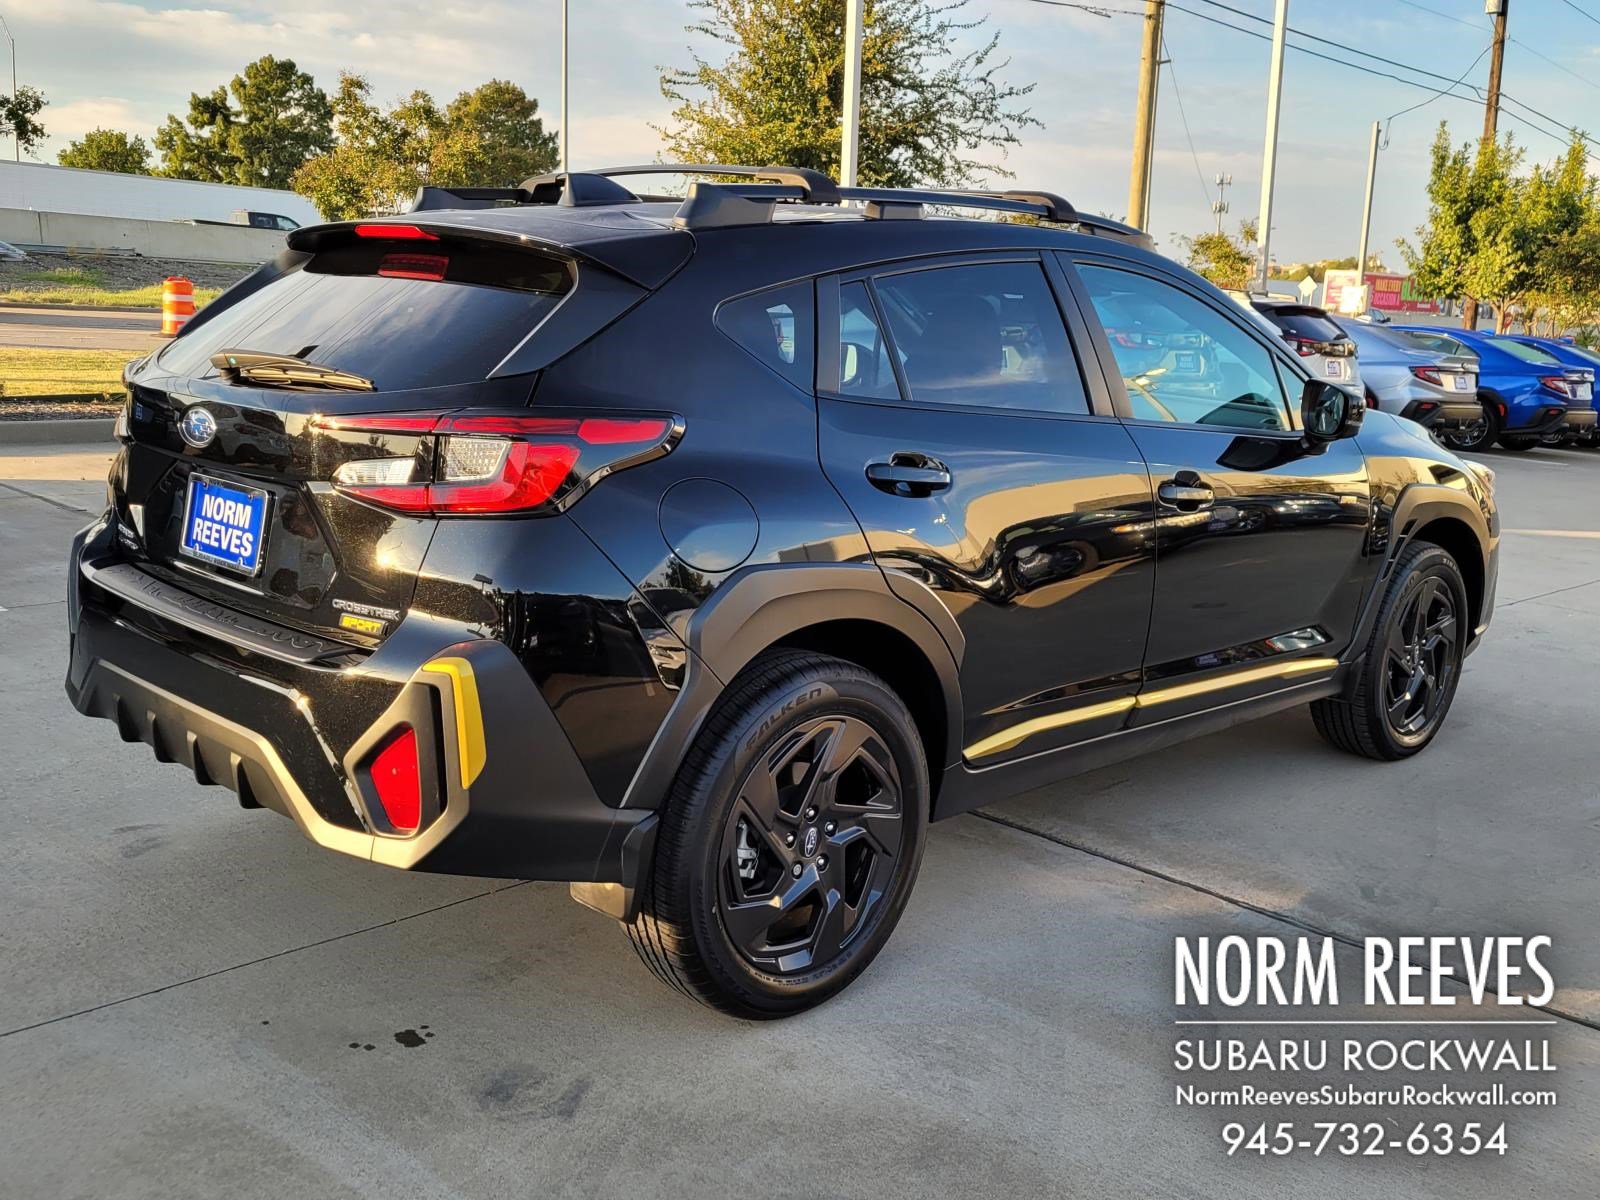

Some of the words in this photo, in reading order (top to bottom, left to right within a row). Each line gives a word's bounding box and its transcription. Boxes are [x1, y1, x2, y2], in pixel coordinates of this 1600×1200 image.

[201, 493, 252, 529] NORM
[192, 517, 254, 557] REEVES
[332, 598, 401, 621] CROSSTREK
[341, 615, 382, 633] SPORT
[745, 687, 822, 752] FALKEN
